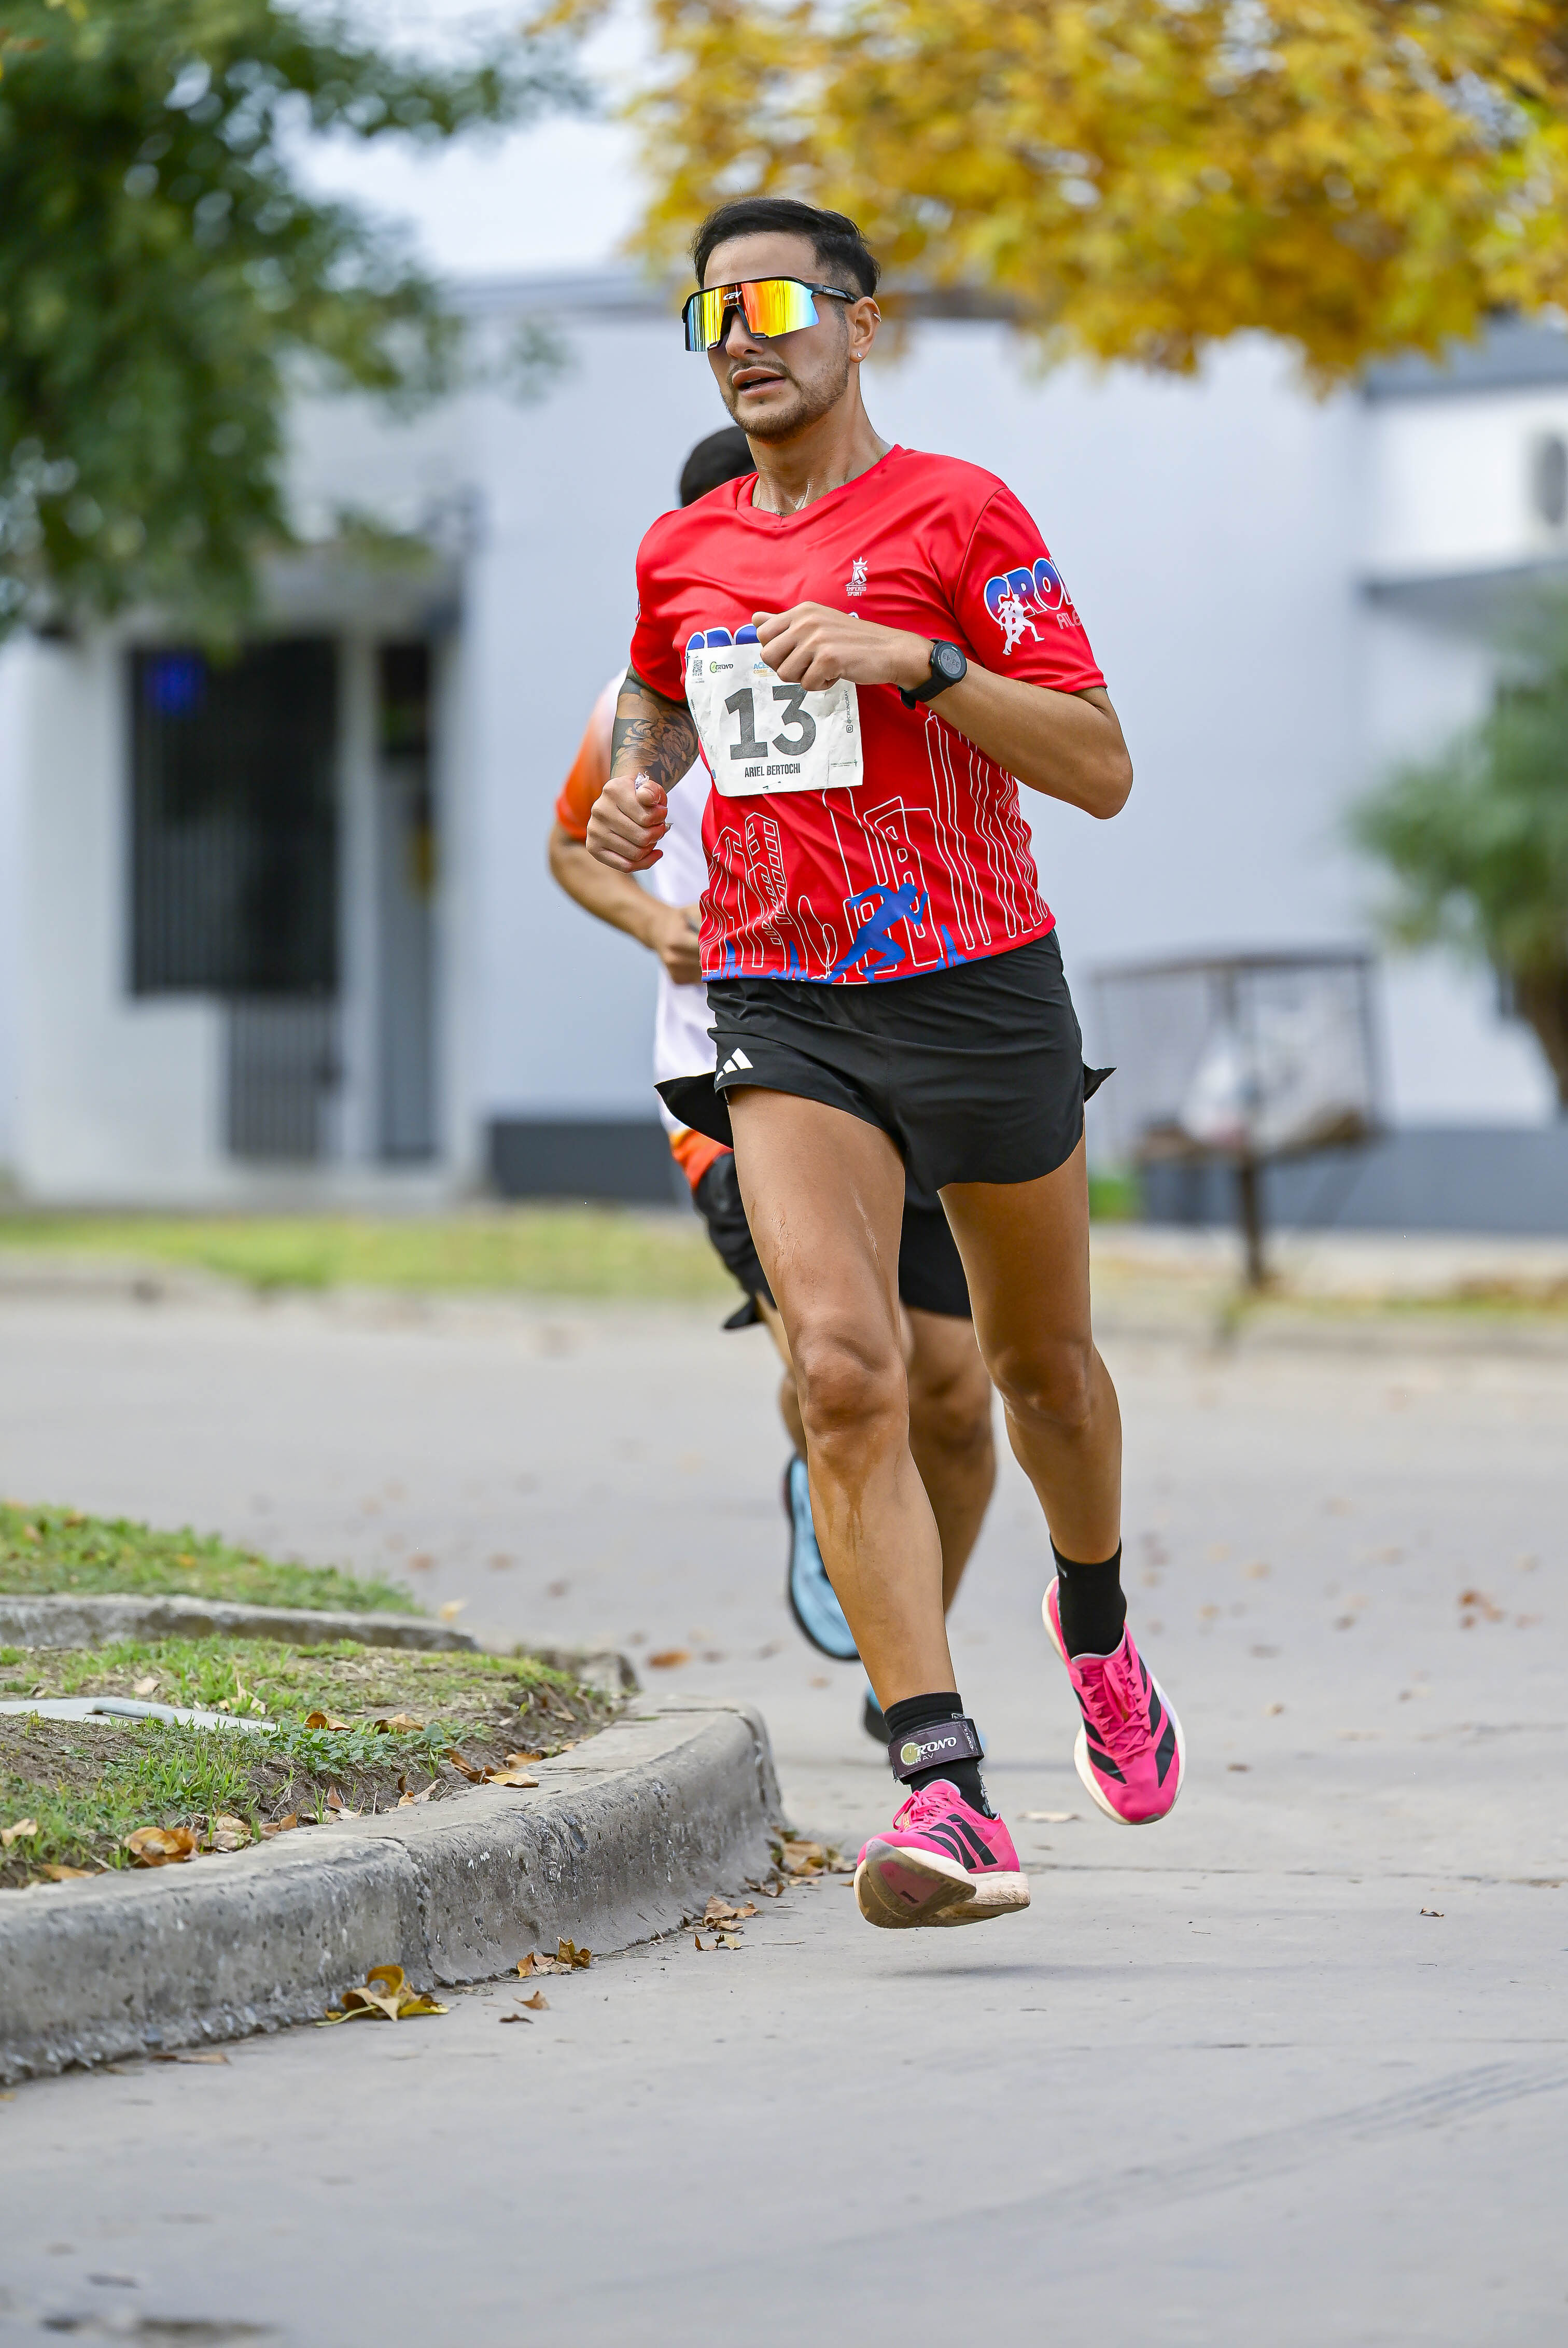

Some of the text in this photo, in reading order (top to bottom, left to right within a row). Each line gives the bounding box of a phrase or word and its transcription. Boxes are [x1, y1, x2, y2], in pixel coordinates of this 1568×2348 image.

[984, 556, 1073, 624] CRO
[724, 684, 816, 760] 13
[844, 690, 852, 724] @CRONORAV
[745, 763, 801, 778] ARIEL BERTOCHI
[915, 1753, 933, 1764] RAV
